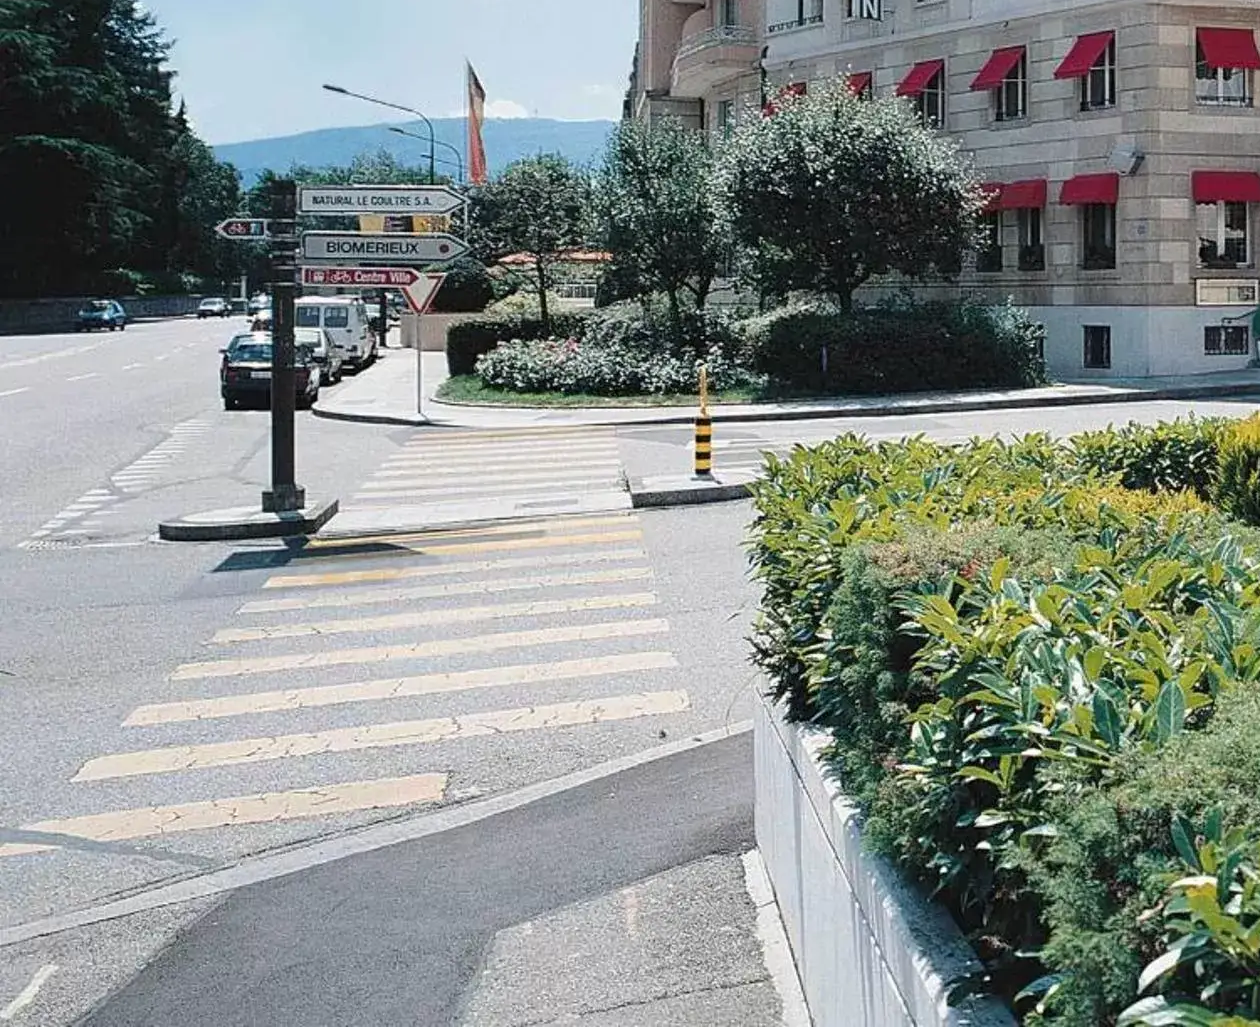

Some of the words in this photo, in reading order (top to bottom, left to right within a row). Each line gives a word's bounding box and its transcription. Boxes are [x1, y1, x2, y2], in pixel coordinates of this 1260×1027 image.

[312, 195, 355, 206] NATURAL
[357, 195, 368, 206] LE
[326, 242, 419, 254] BIOMERIEUX
[354, 271, 387, 283] Centre
[389, 271, 411, 283] Ville
